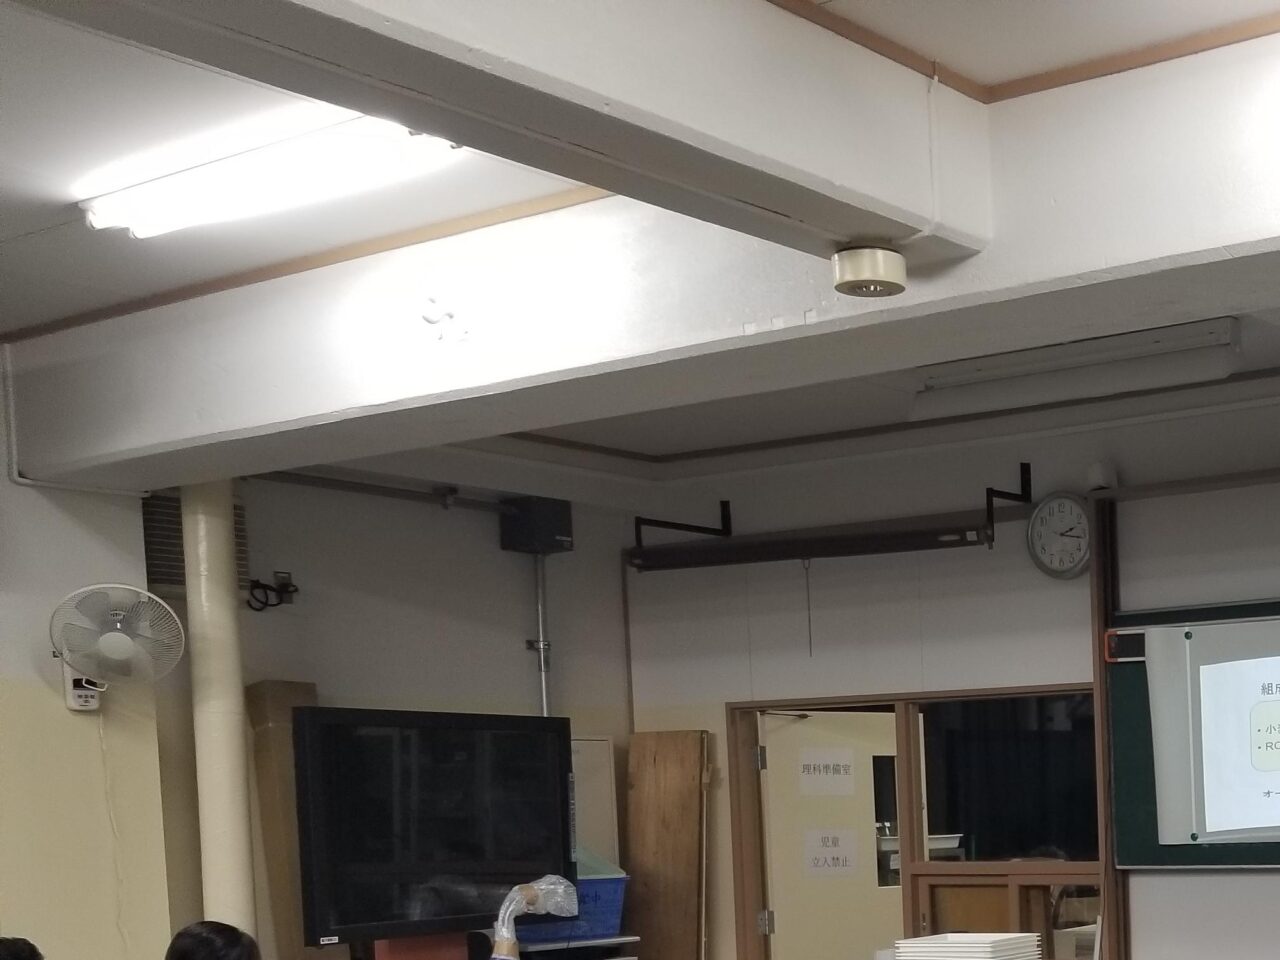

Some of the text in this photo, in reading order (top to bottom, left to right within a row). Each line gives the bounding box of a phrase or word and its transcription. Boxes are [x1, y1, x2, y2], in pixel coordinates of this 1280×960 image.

[801, 763, 852, 776] 理科準備室
[811, 856, 850, 868] 立入禁止
